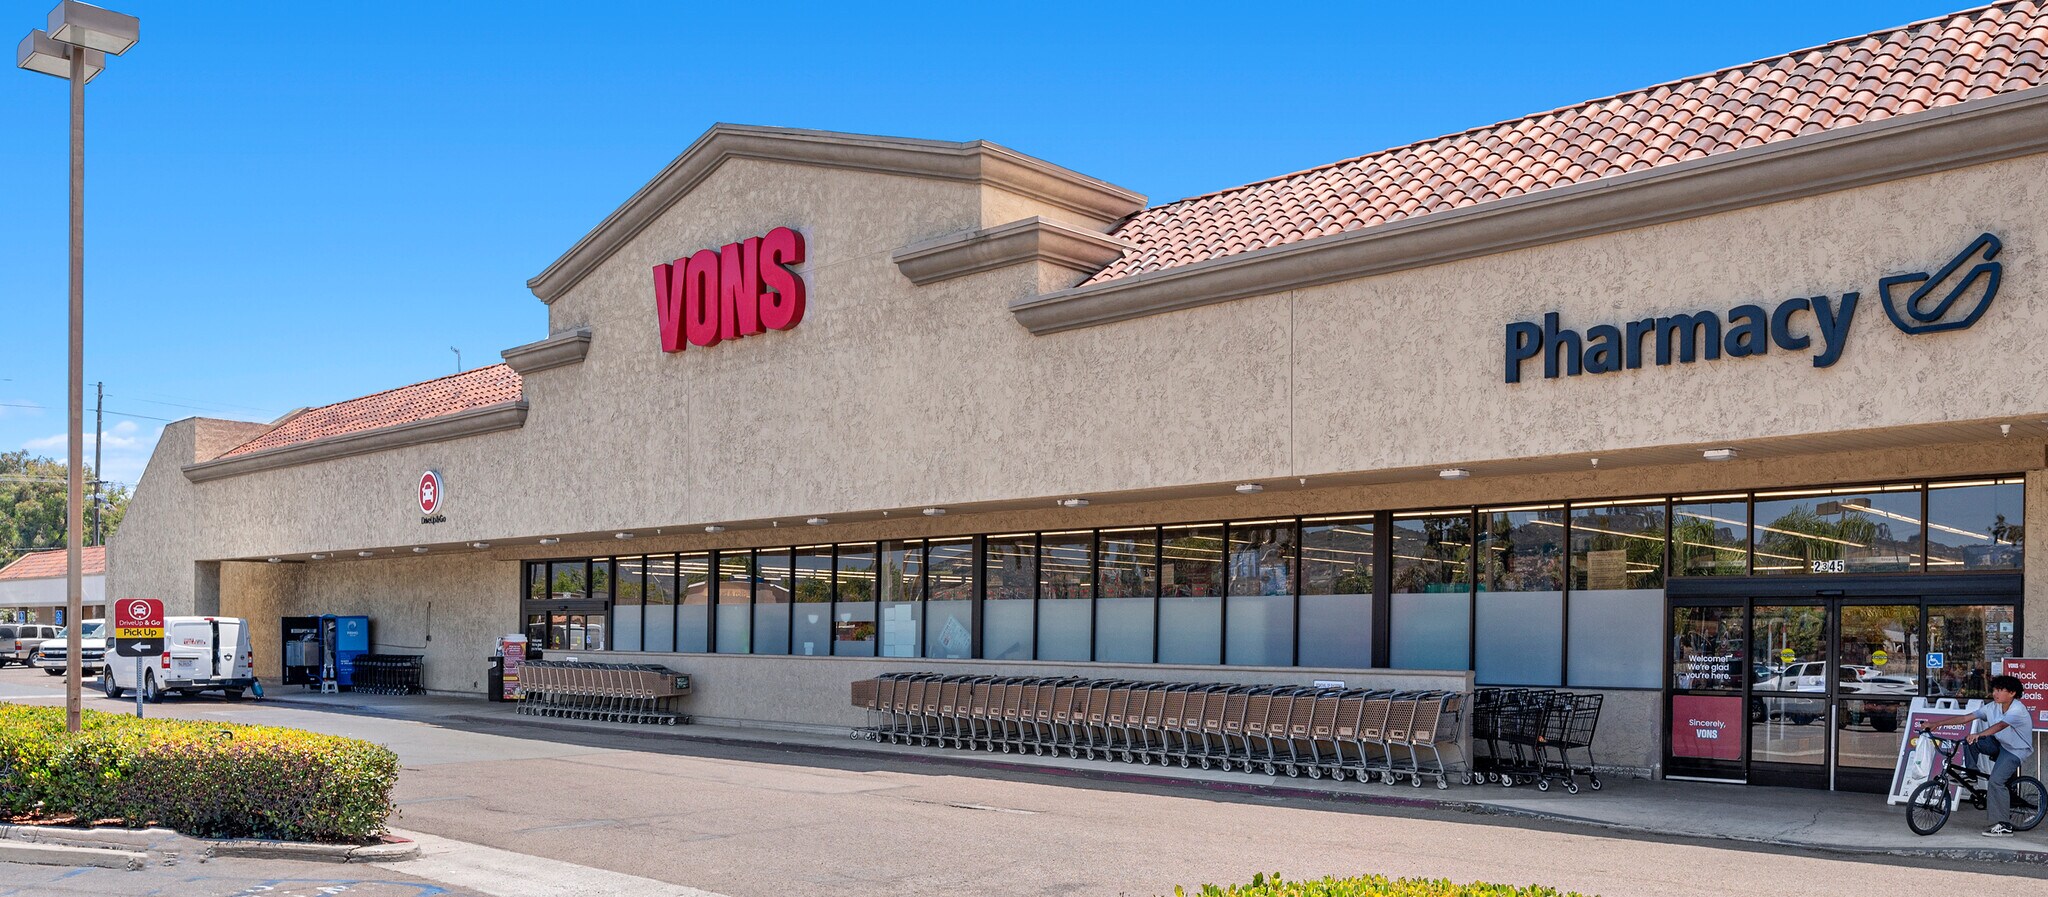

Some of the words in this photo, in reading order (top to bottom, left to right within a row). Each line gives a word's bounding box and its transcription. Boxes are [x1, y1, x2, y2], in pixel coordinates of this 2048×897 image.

[653, 227, 806, 353] VONS
[1505, 291, 1861, 383] Pharmacy
[1814, 561, 1843, 573] 2345
[144, 629, 157, 638] Up
[1687, 663, 1710, 671] We're
[1711, 663, 1729, 673] glad
[1686, 672, 1710, 681] you're
[1711, 672, 1731, 680] here.
[1689, 719, 1726, 729] Sincerely,
[1696, 729, 1718, 739] VONS
